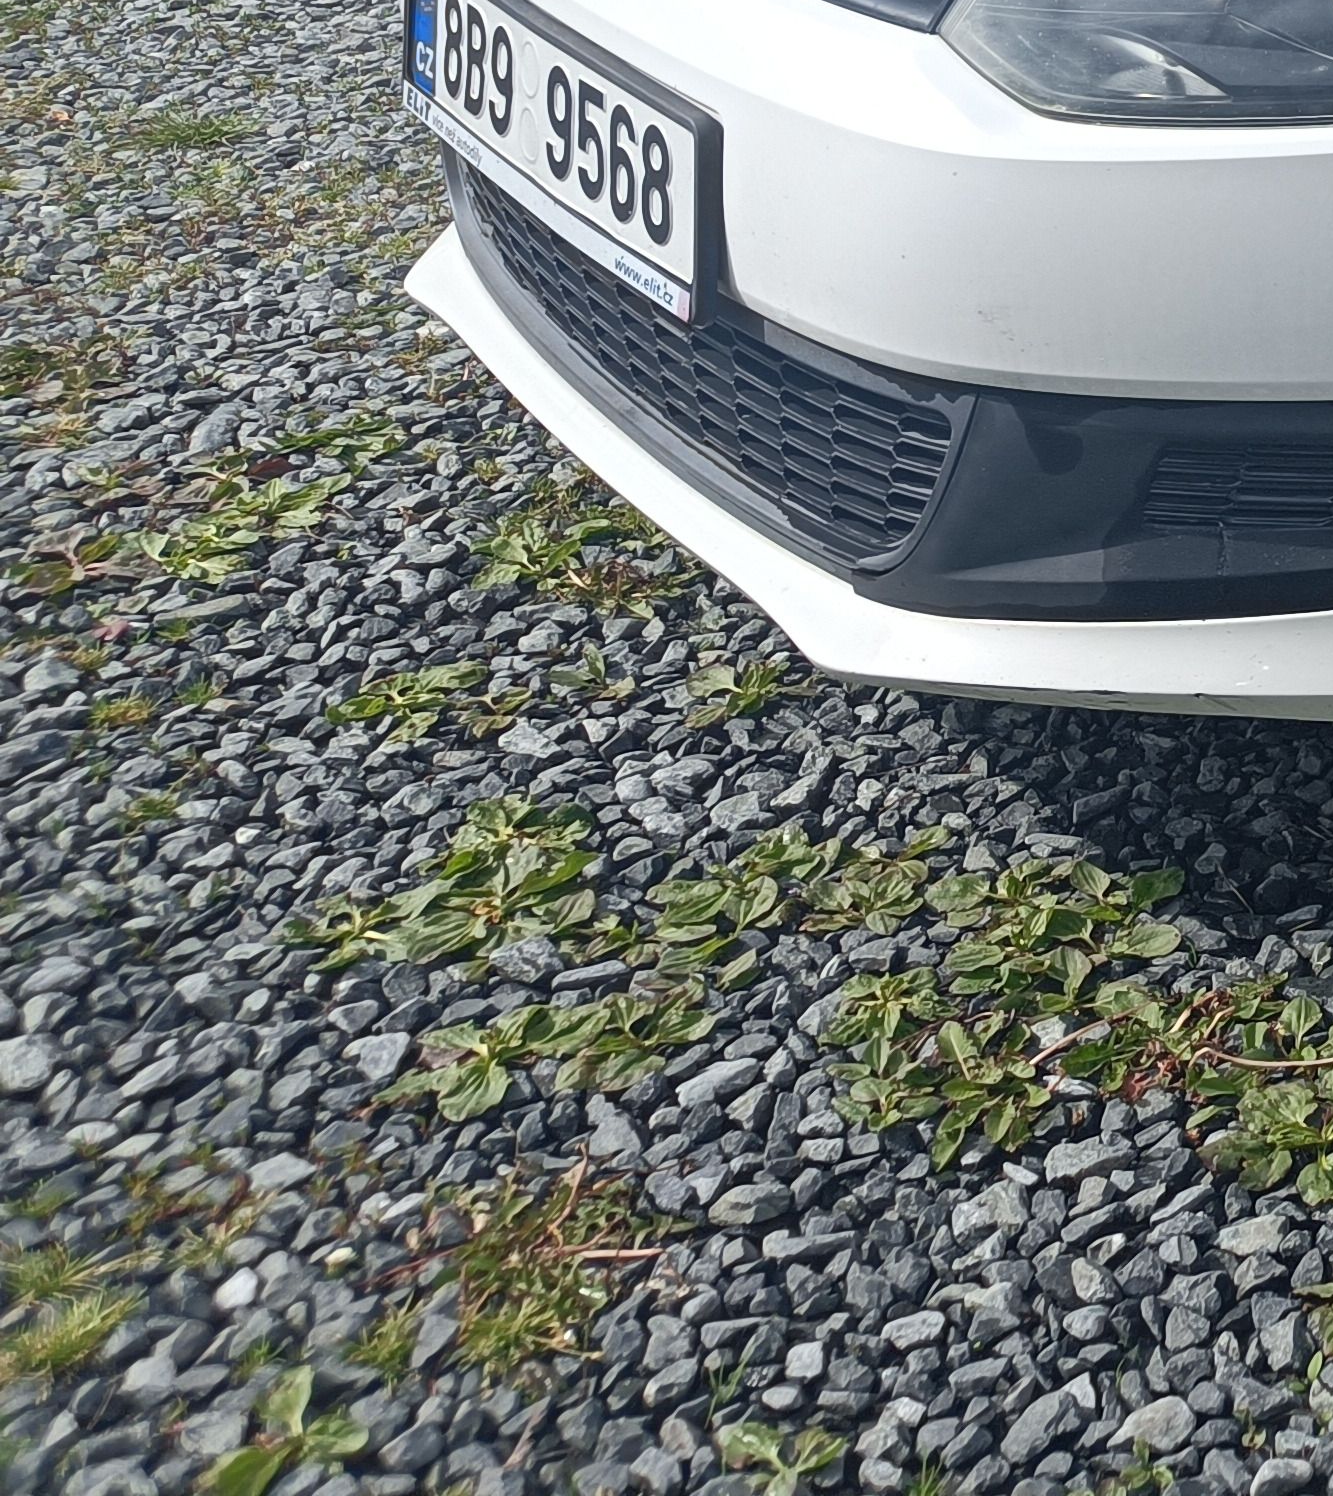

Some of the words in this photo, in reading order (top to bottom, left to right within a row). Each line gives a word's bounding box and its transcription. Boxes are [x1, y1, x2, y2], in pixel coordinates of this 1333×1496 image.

[415, 39, 435, 79] CZ
[545, 65, 672, 246] 9568
[615, 257, 674, 306] www.elit.cz
